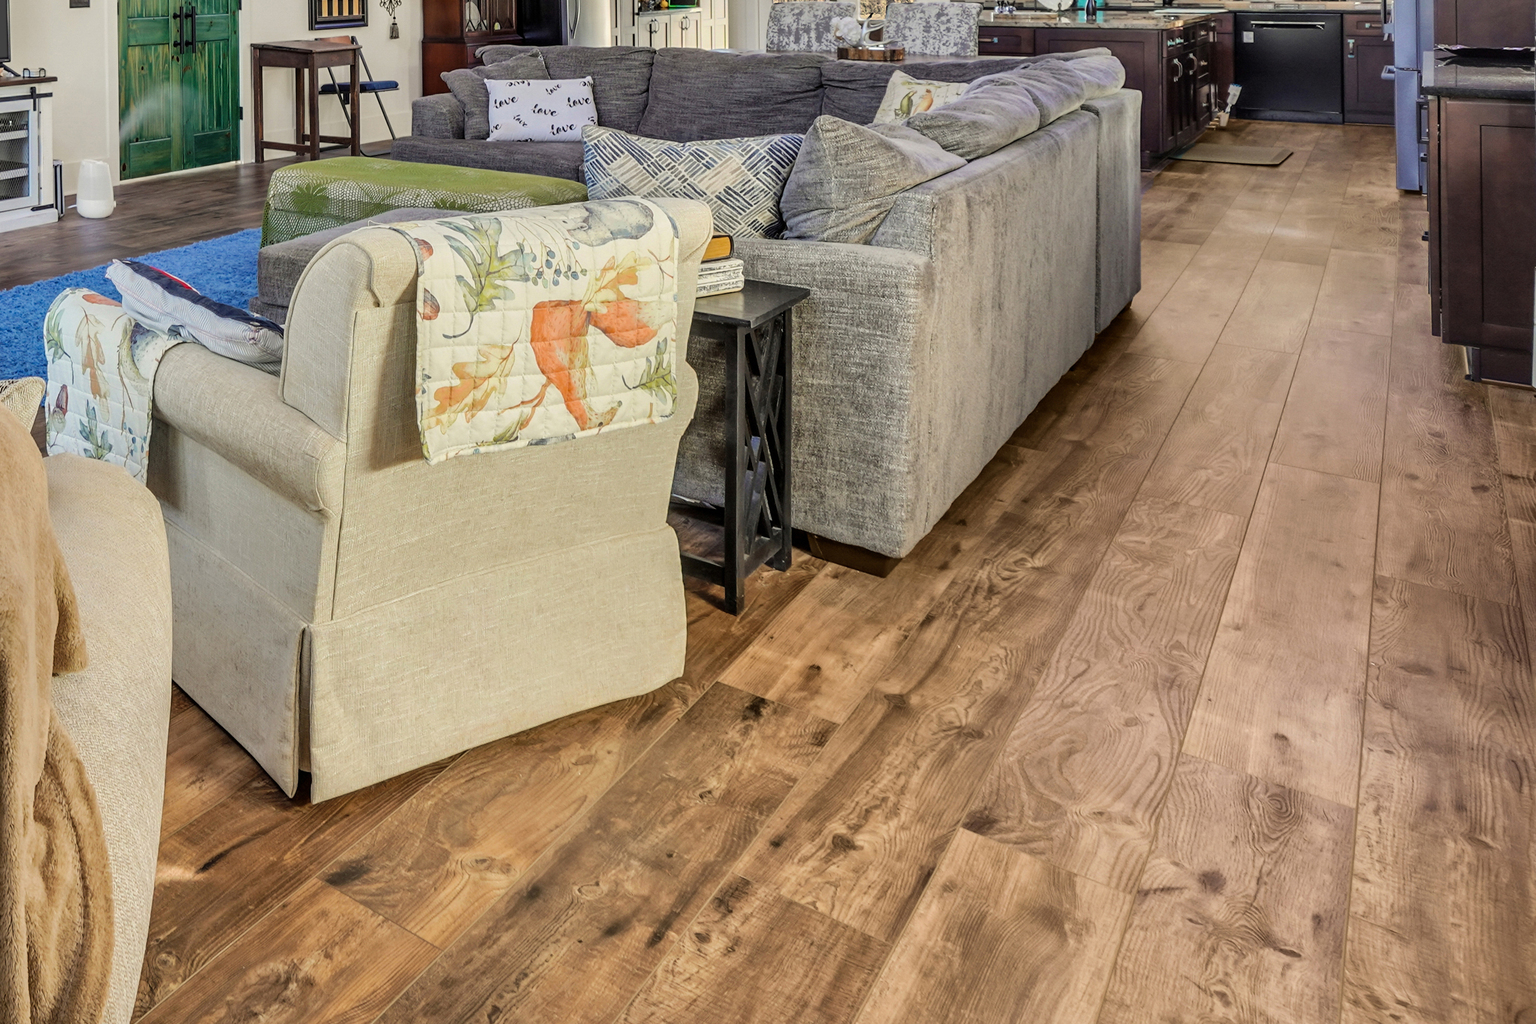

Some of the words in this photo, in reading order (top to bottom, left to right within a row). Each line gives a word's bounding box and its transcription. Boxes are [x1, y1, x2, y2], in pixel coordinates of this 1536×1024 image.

[545, 84, 562, 95] love
[493, 96, 519, 109] love
[566, 97, 594, 108] love
[531, 104, 559, 116] love
[490, 123, 503, 133] ve
[549, 123, 578, 136] love
